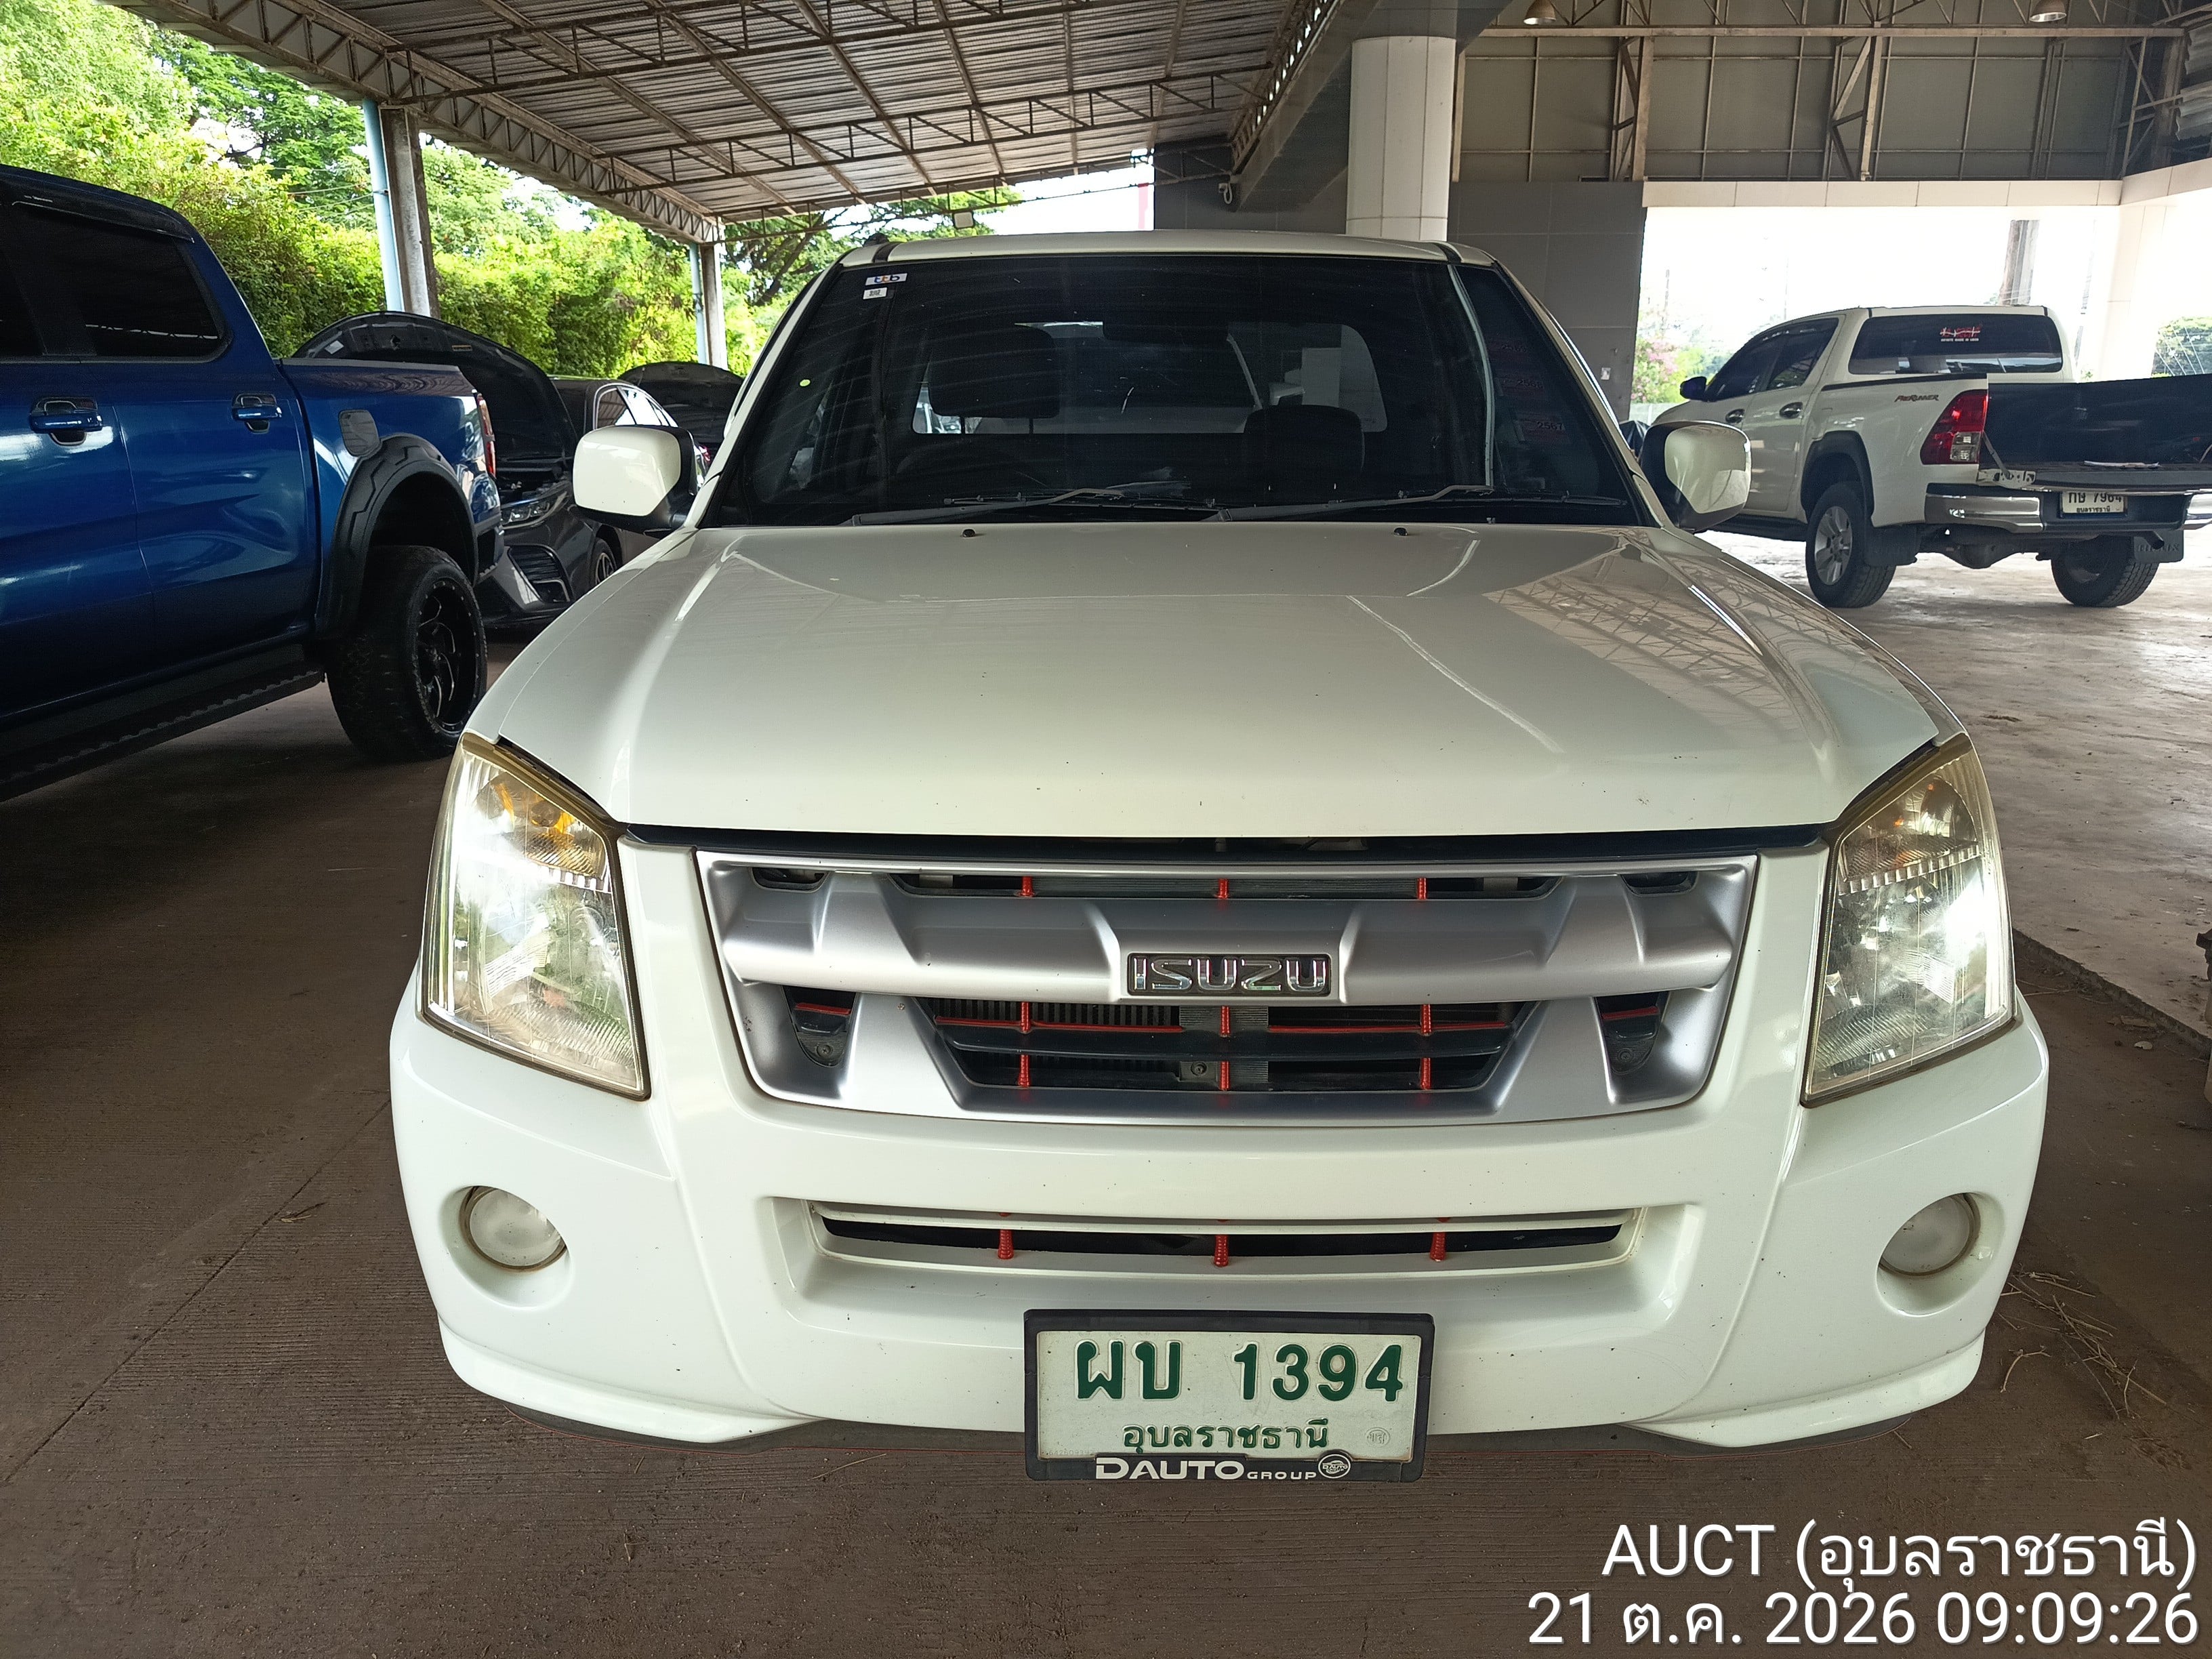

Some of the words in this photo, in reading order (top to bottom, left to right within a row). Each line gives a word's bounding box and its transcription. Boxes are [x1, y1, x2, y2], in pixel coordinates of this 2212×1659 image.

[1537, 422, 1562, 430] 2567
[1133, 958, 1327, 992] ISUZU
[1076, 1340, 1182, 1400] ผบ
[1234, 1344, 1403, 1401] 1394
[1124, 1418, 1328, 1454] อุบลราชธานี
[1096, 1457, 1244, 1479] DAUTO
[1247, 1471, 1317, 1480] GROUP
